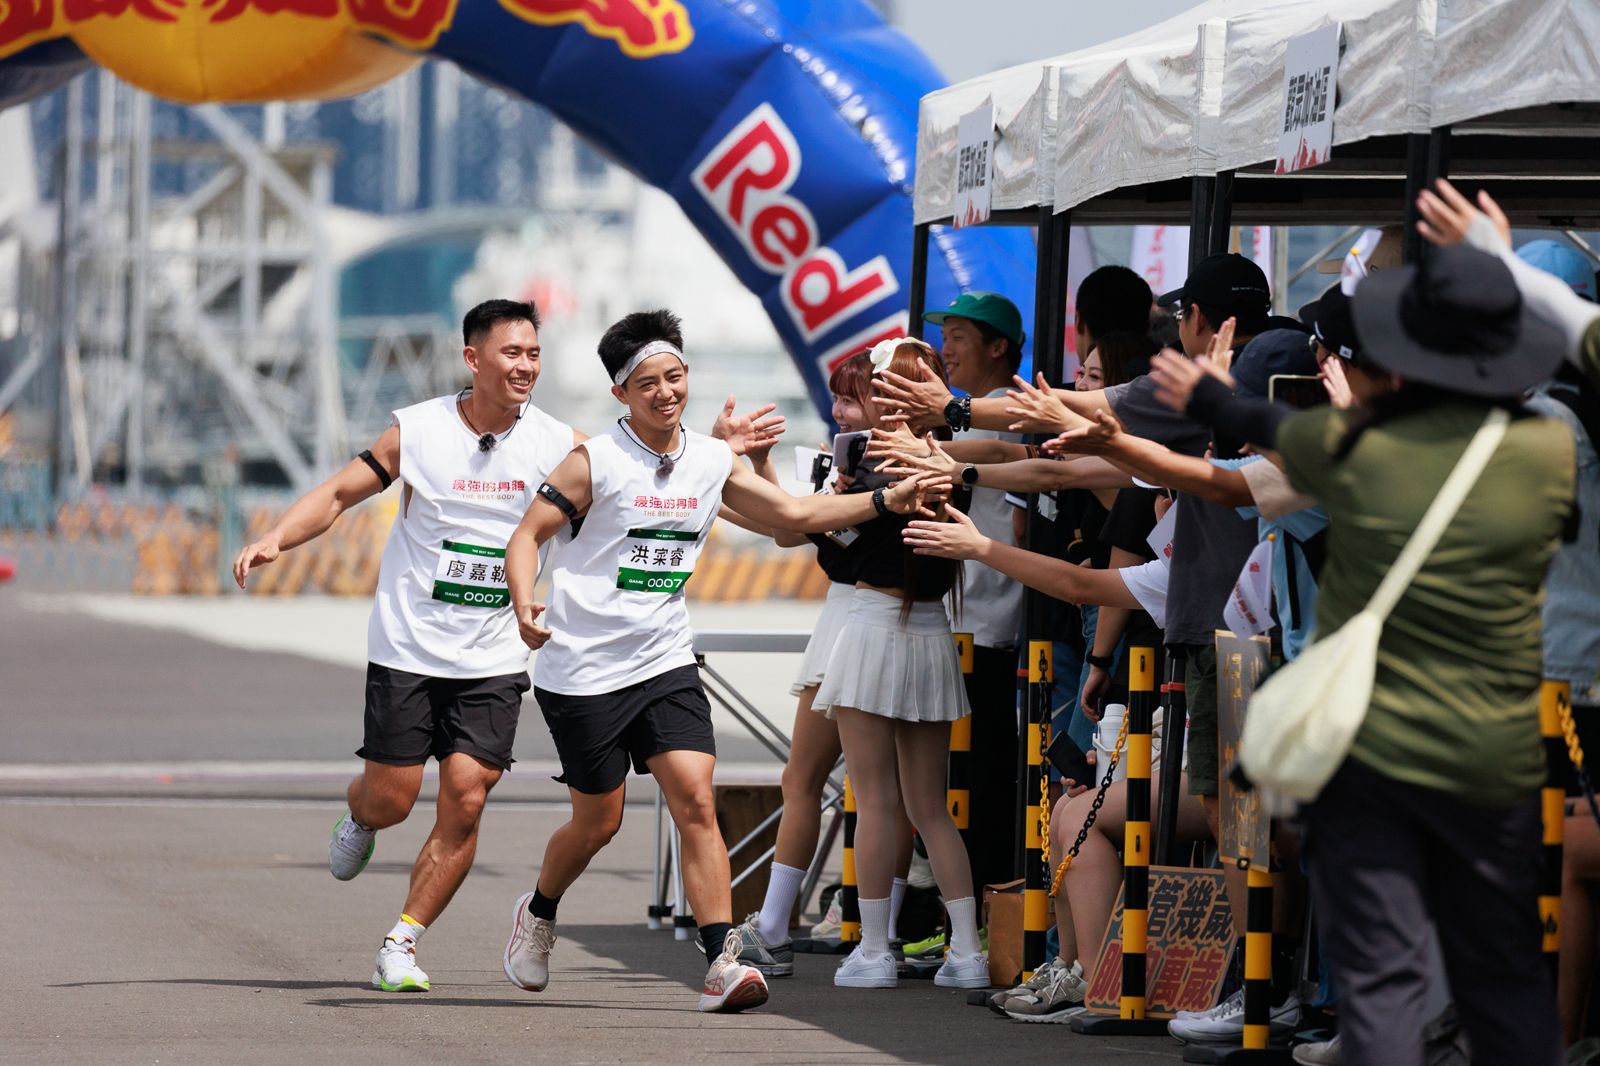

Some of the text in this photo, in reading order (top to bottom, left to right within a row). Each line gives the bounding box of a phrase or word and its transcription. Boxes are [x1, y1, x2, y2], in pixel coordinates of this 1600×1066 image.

[693, 104, 897, 343] Red
[657, 510, 674, 518] BEST
[630, 544, 684, 567] 洪寀睿
[647, 578, 684, 588] 0007
[464, 591, 504, 604] 0007
[1115, 877, 1233, 939] 管幾歲
